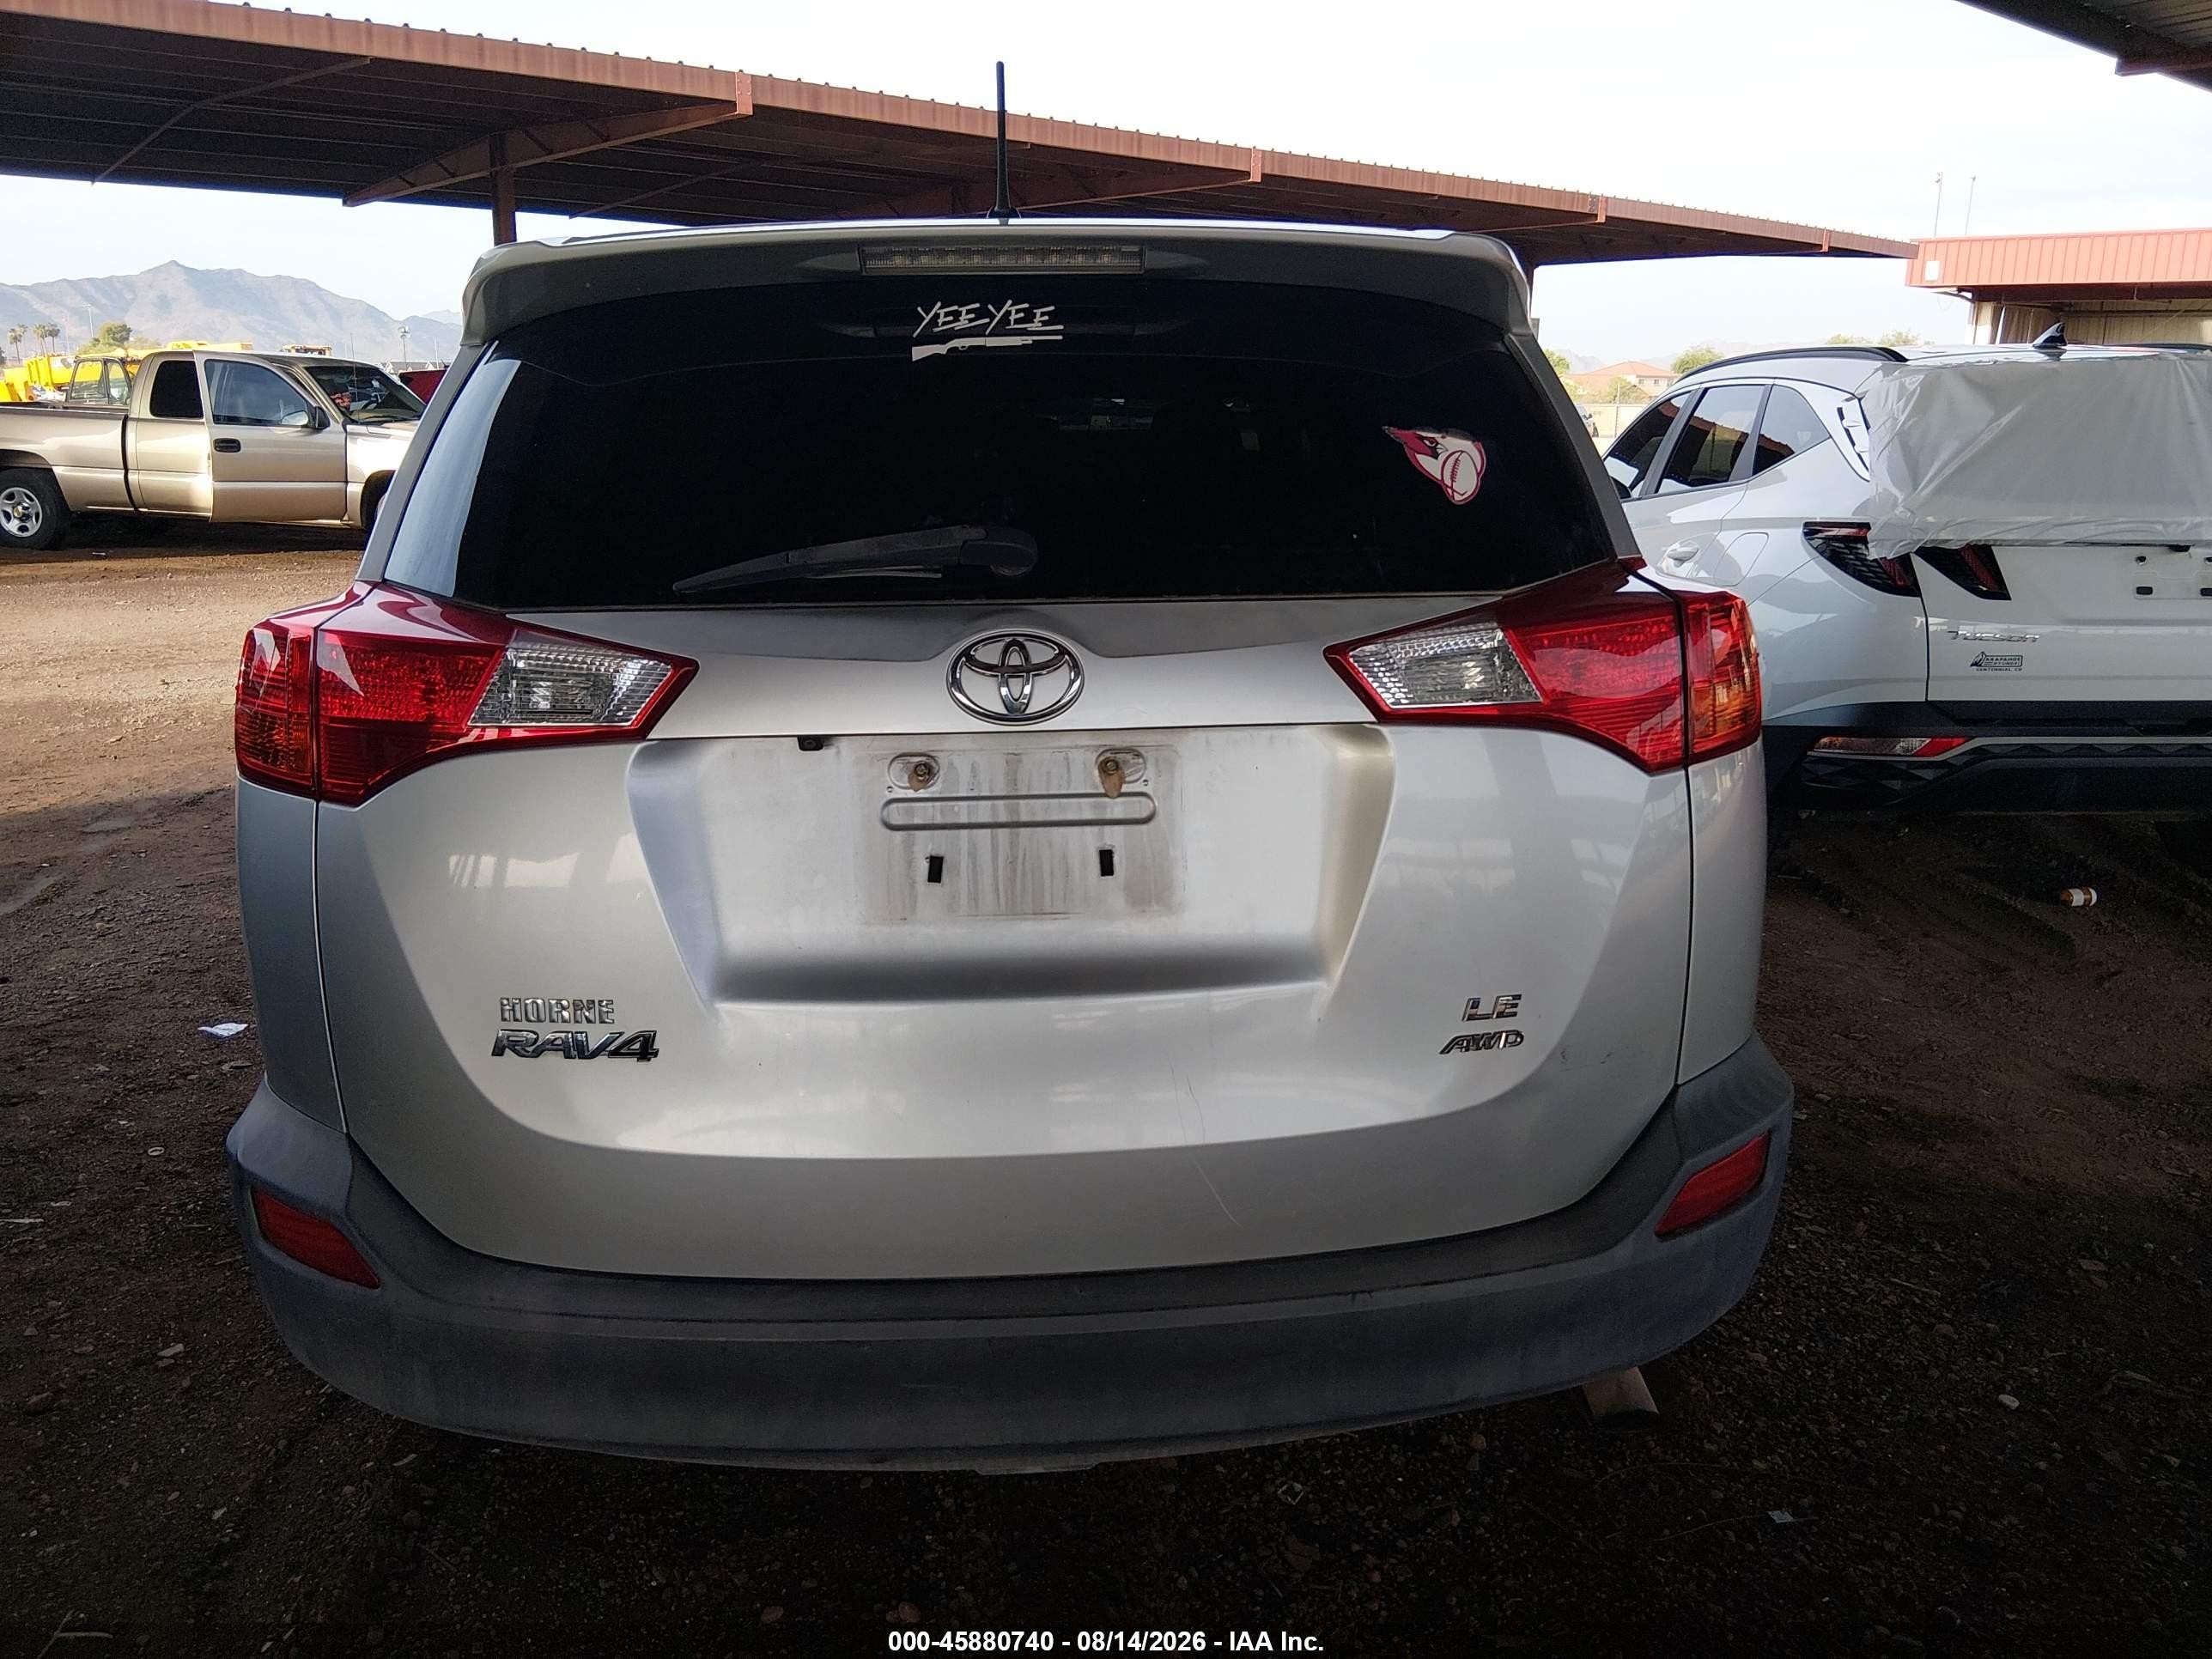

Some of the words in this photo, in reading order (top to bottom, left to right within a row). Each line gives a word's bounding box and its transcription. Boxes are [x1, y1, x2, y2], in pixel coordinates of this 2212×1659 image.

[912, 301, 990, 337] YEE
[985, 299, 1065, 336] YEE
[500, 997, 616, 1024] HORNE
[1462, 994, 1522, 1022] LE
[490, 1029, 660, 1063] RAV4
[1438, 1029, 1525, 1055] AWD
